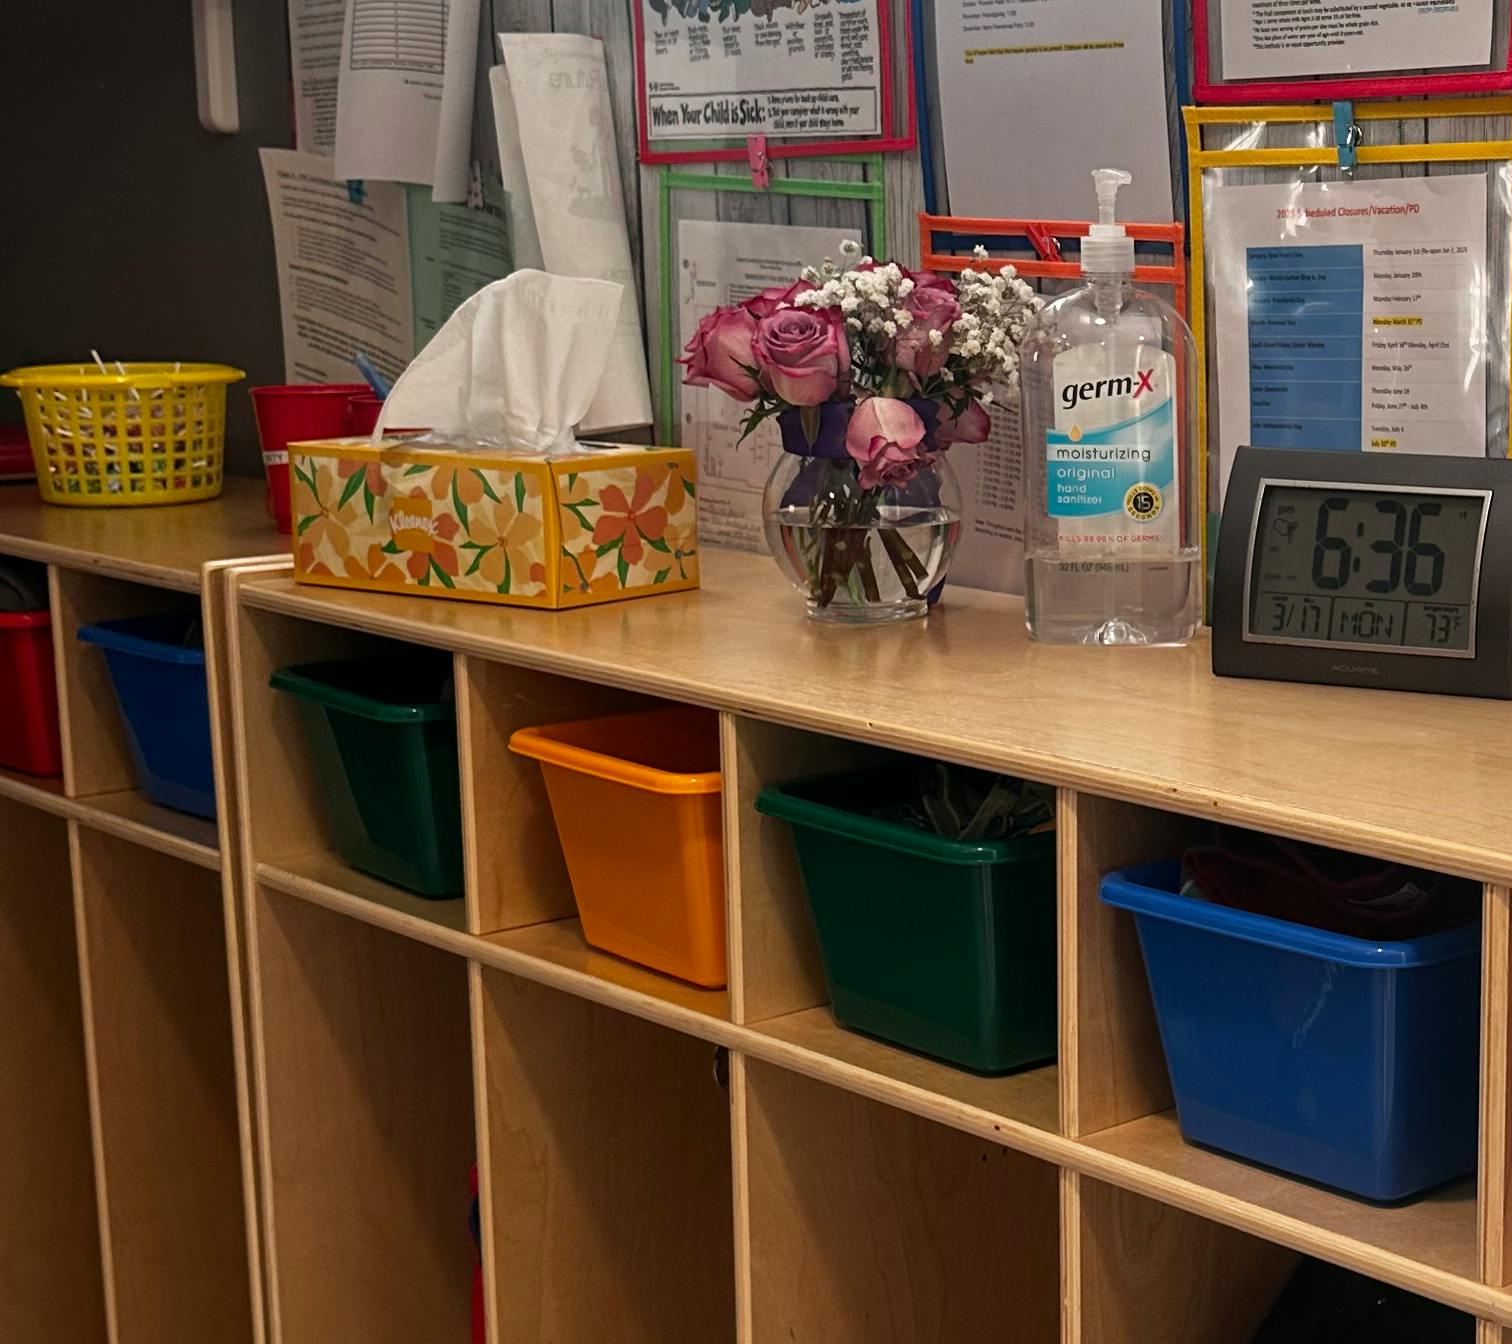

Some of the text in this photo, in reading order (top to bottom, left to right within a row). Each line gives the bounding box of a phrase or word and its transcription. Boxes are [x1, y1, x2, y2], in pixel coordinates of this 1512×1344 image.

[652, 105, 680, 127] When
[680, 103, 702, 124] Your
[703, 99, 730, 124] Child
[730, 103, 739, 123] is
[739, 98, 766, 126] Sick:
[1062, 368, 1154, 410] germ-X
[1056, 448, 1151, 462] moisturizing
[1057, 466, 1116, 481] original
[1057, 483, 1087, 494] hand
[1057, 494, 1103, 506] sanitizer
[1136, 494, 1151, 511] 15
[1312, 497, 1445, 596] 6:36
[1272, 603, 1321, 634] 3/17
[1340, 610, 1394, 639] MON
